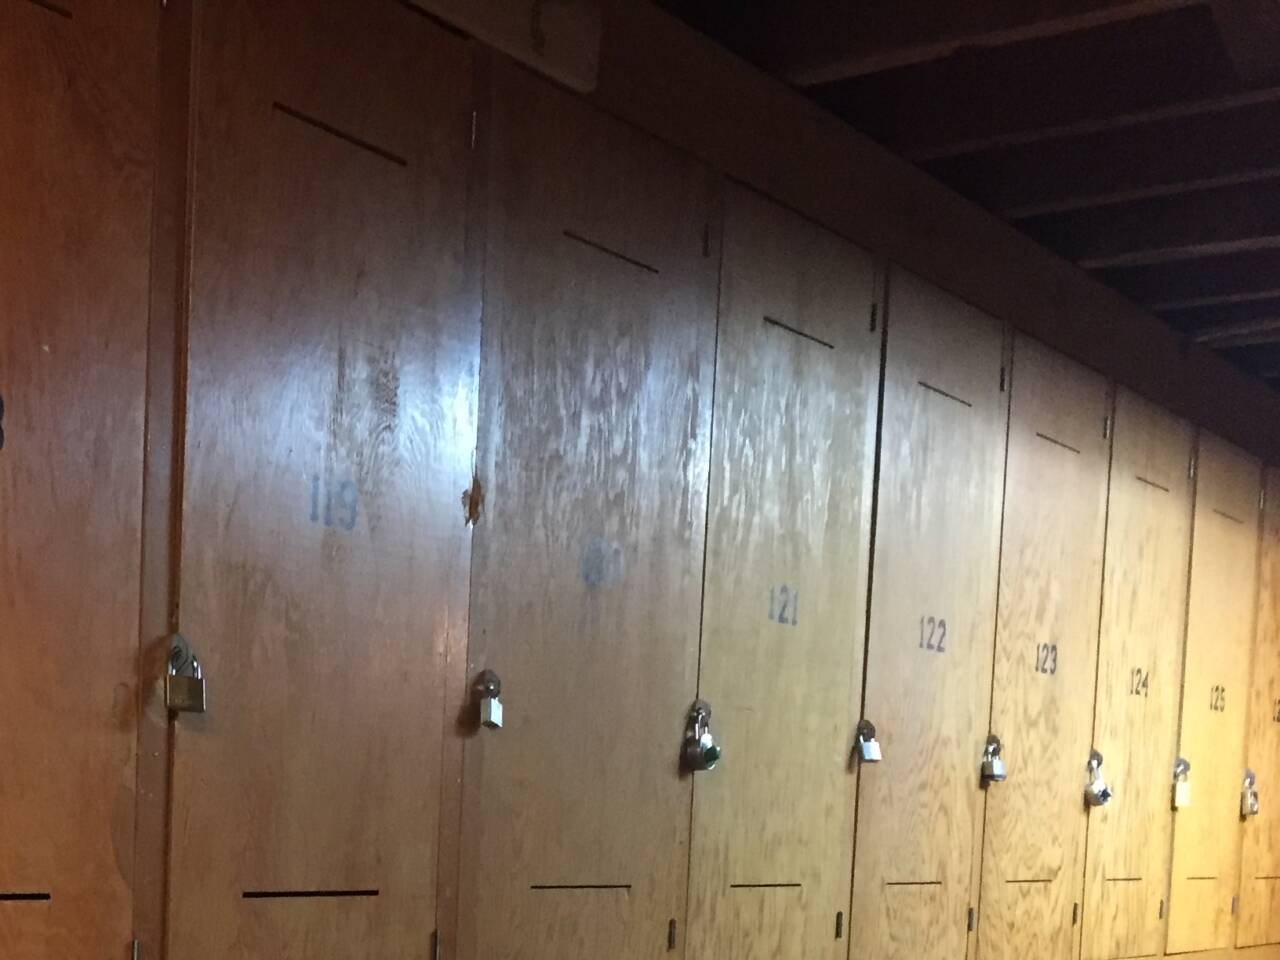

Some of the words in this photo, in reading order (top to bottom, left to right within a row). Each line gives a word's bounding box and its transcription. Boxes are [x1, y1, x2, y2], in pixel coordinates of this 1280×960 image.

[308, 473, 358, 531] 119
[768, 584, 799, 626] 121
[919, 616, 947, 653] 122
[1035, 643, 1058, 675] 123
[1130, 668, 1149, 698] 124
